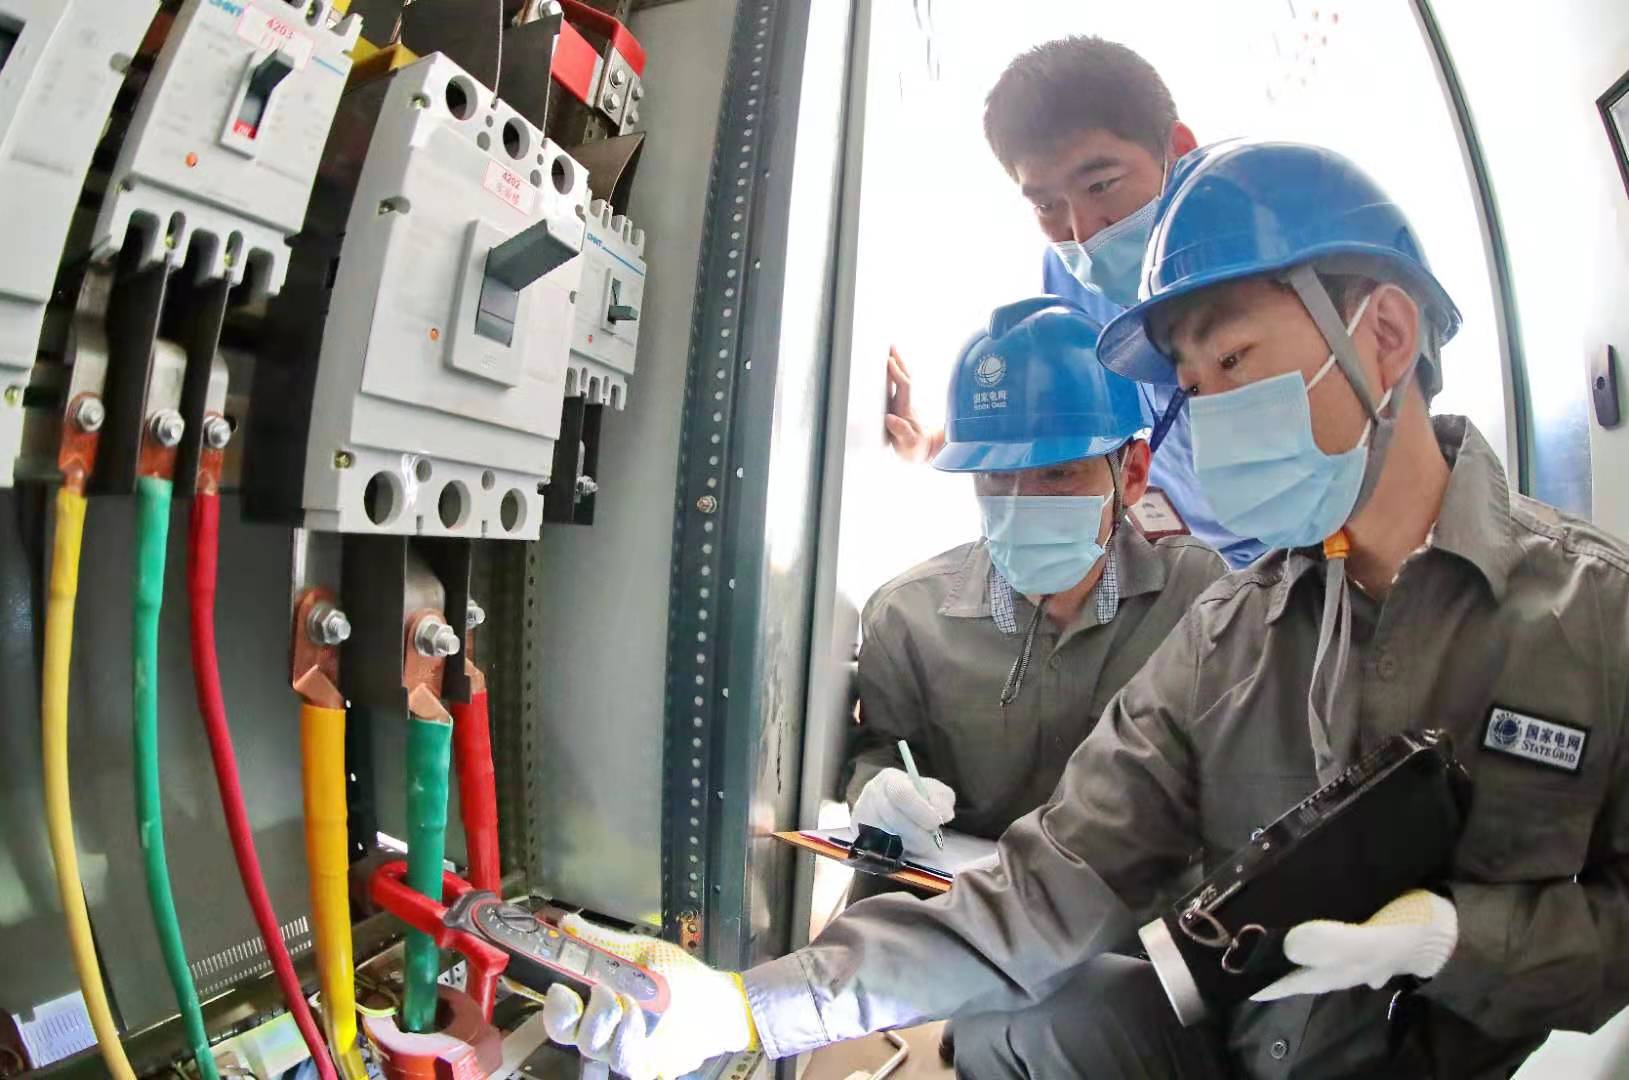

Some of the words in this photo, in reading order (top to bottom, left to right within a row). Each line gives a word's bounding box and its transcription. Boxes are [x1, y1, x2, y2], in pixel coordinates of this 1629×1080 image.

[266, 16, 295, 40] 4203
[1525, 723, 1581, 752] 国家电网
